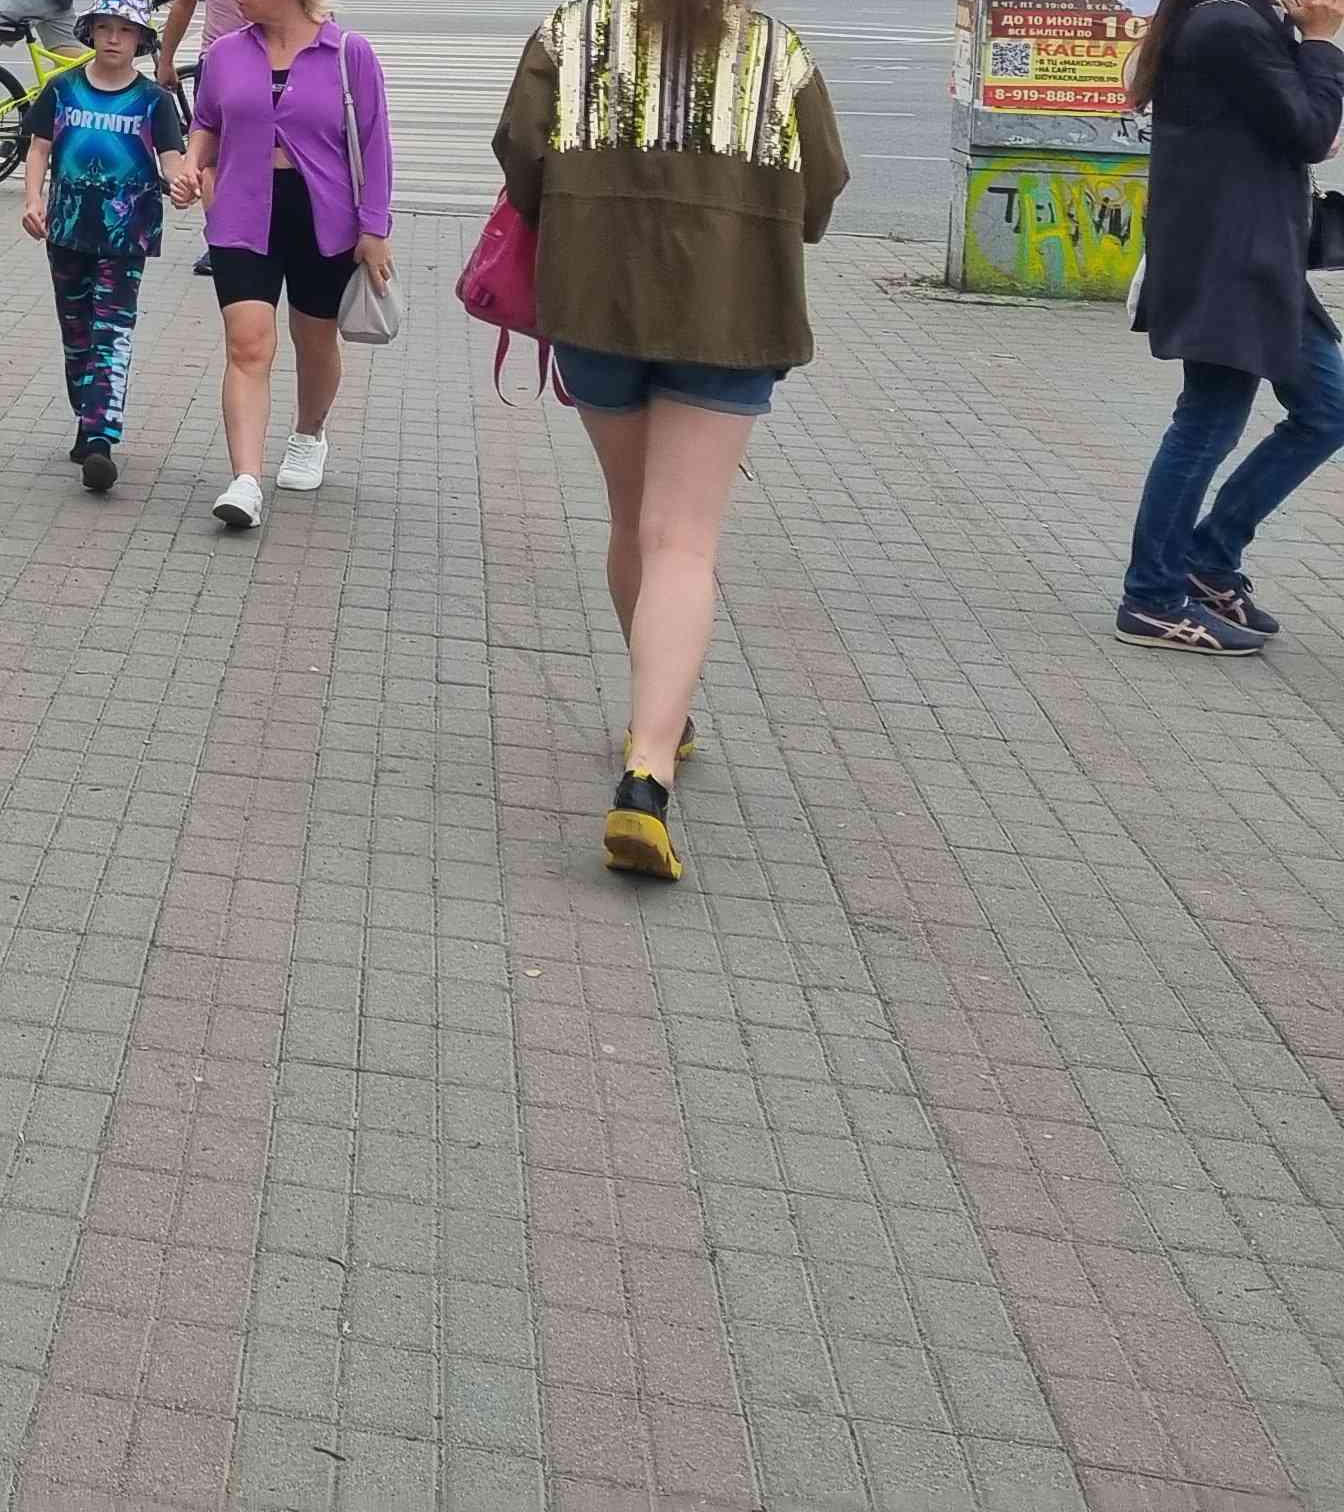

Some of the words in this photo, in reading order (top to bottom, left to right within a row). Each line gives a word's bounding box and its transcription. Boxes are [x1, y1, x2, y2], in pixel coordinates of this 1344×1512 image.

[1001, 15, 1024, 27] ДО
[1027, 16, 1043, 26] 10
[1046, 16, 1093, 27] ИЮНЯ
[1008, 28, 1027, 36] ВСЕ
[1029, 28, 1075, 37] БИЛЕТЫ
[1077, 29, 1093, 37] ПО
[1036, 43, 1118, 58] КАССА
[1051, 66, 1077, 74] САЙТЕ
[994, 88, 1127, 104] 8-919-888-71-89
[64, 106, 145, 135] FORTNITE
